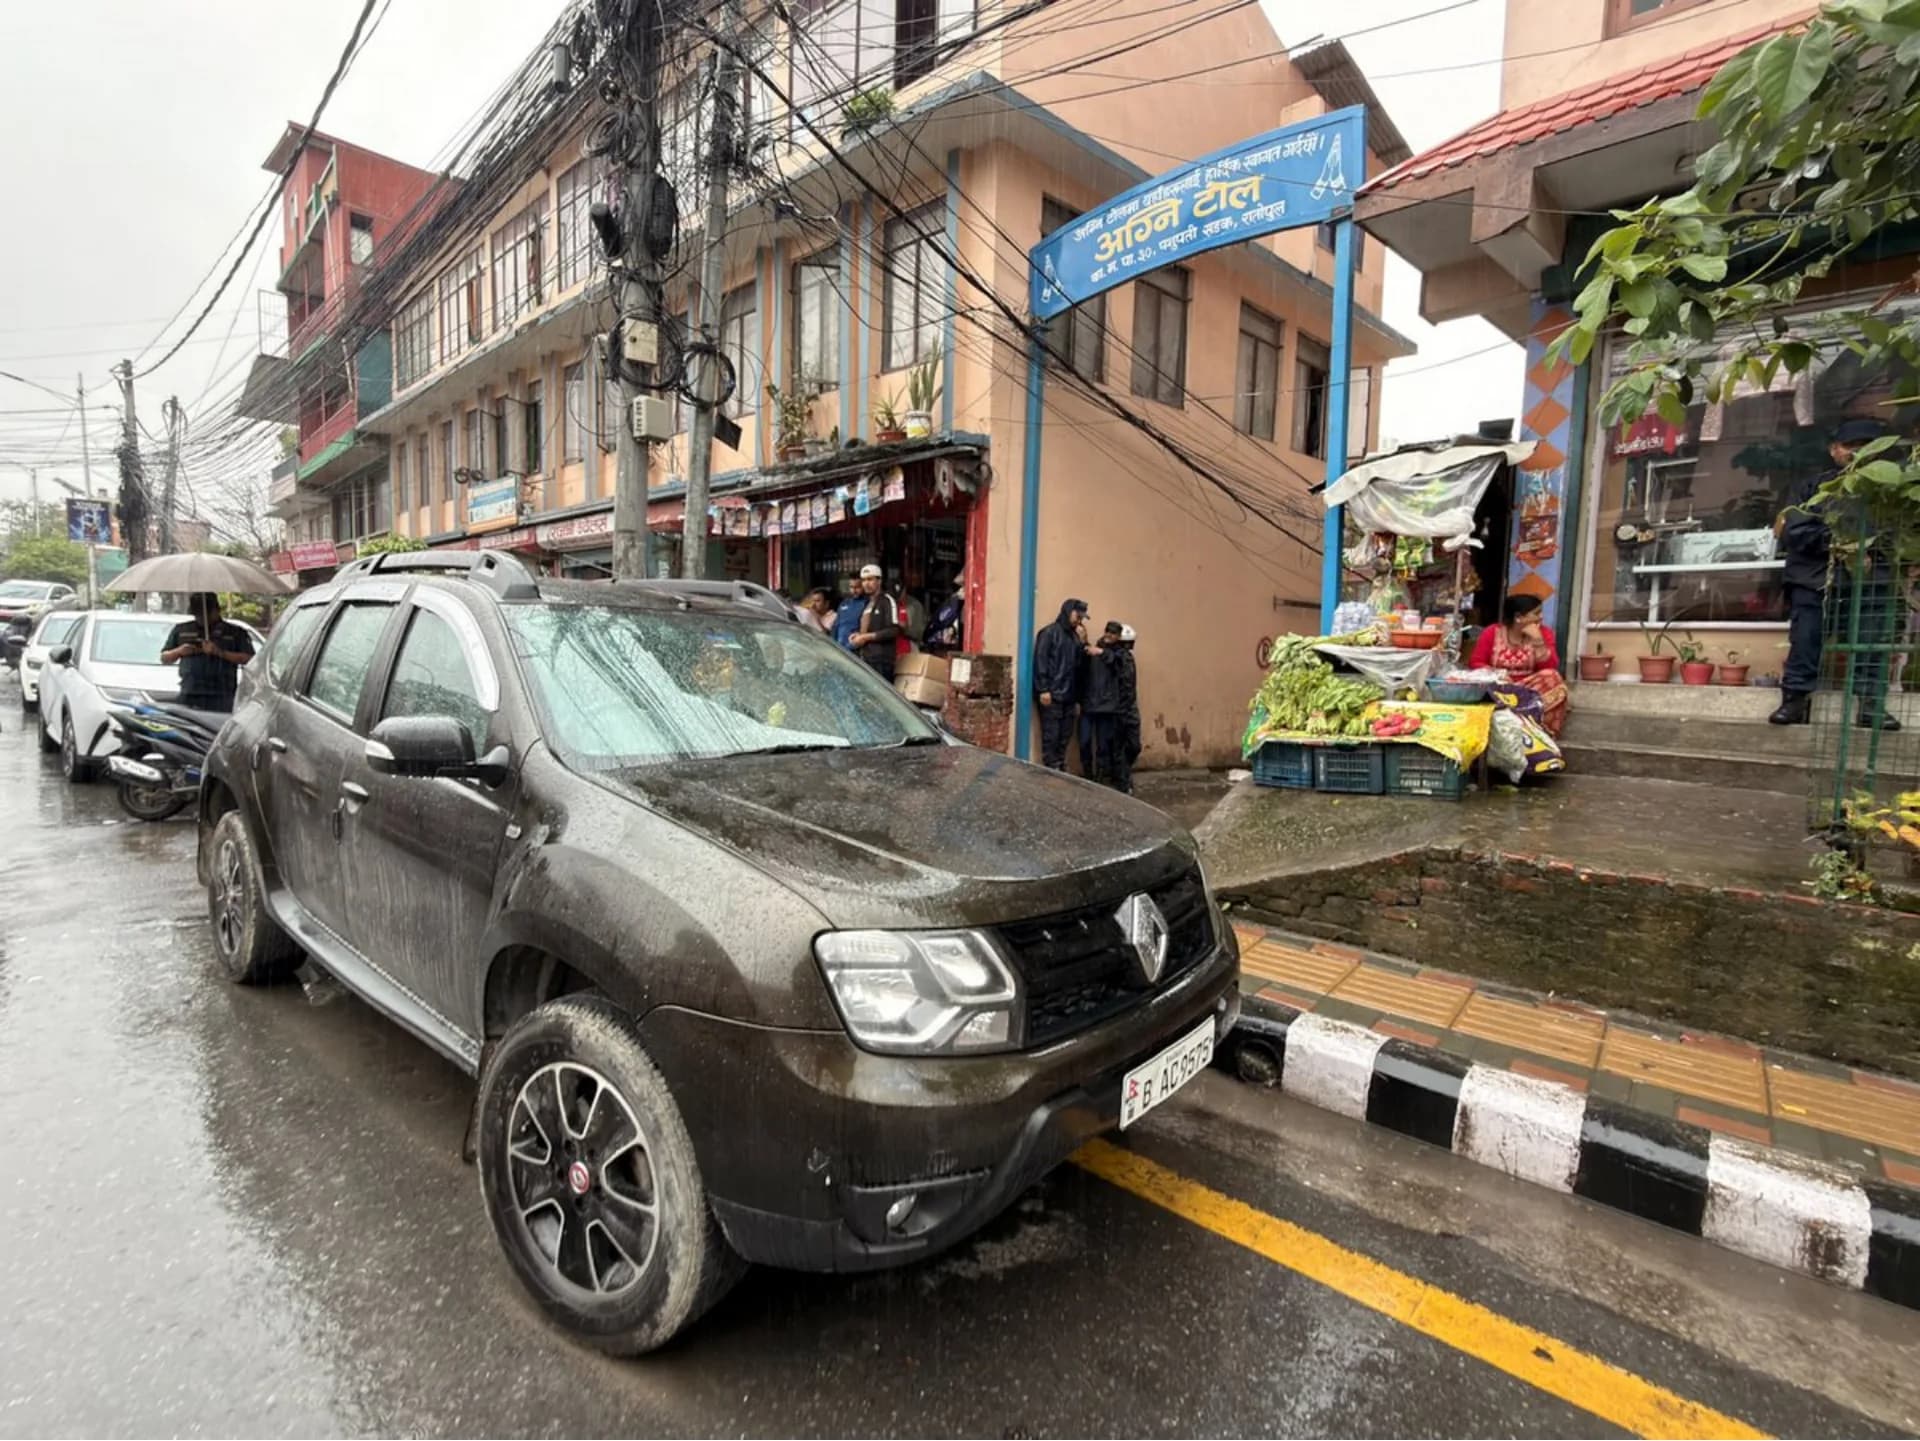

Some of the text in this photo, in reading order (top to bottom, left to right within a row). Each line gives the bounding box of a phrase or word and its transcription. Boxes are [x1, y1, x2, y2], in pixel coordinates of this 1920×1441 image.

[1073, 217, 1104, 242] अग्नि
[1106, 200, 1139, 224] टोलमा
[1204, 157, 1242, 182] हार्दिक
[1243, 145, 1282, 172] स्वागत
[1241, 200, 1286, 226] रातोपुल
[1094, 198, 1182, 262] अग्नि
[1142, 1079, 1153, 1110] B
